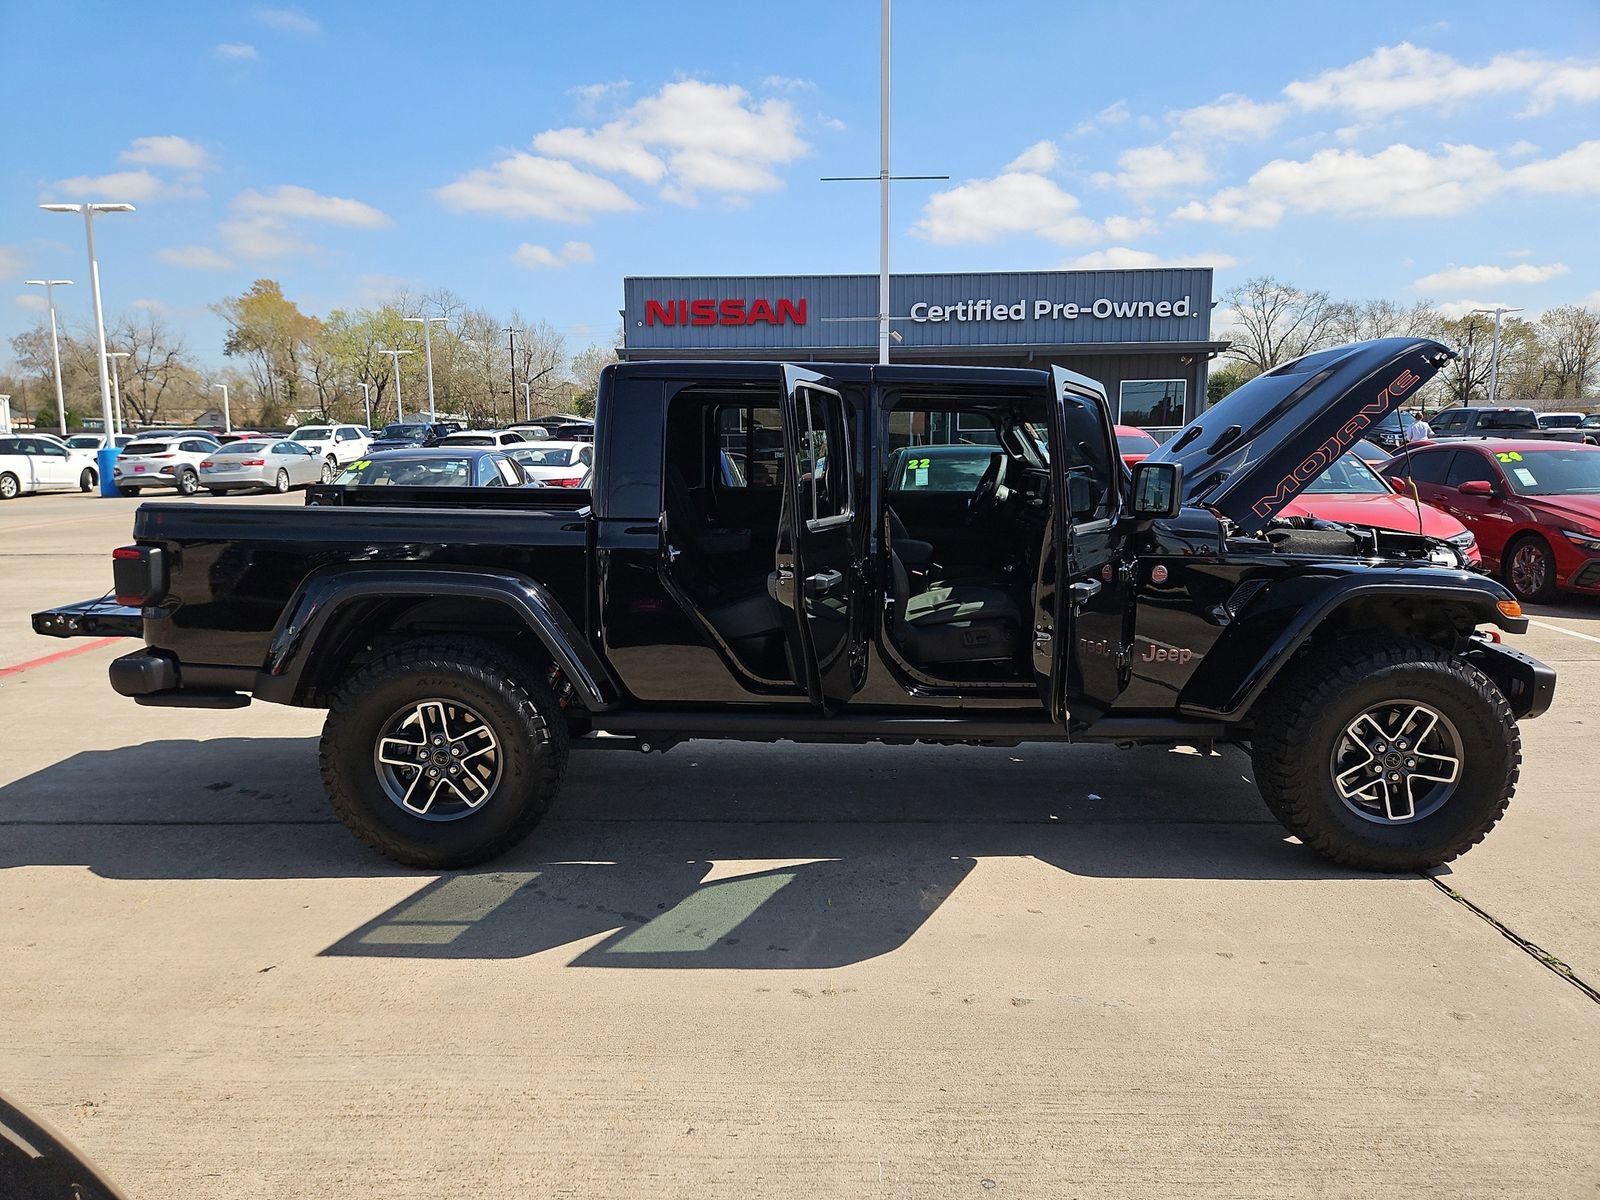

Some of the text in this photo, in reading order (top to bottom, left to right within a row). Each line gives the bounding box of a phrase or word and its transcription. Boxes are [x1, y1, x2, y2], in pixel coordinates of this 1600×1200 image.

[645, 297, 808, 327] NISSAN
[910, 299, 1026, 322] Certified
[1252, 368, 1420, 518] MOJAVE
[907, 458, 930, 470] 22
[1141, 644, 1192, 665] Jeep
